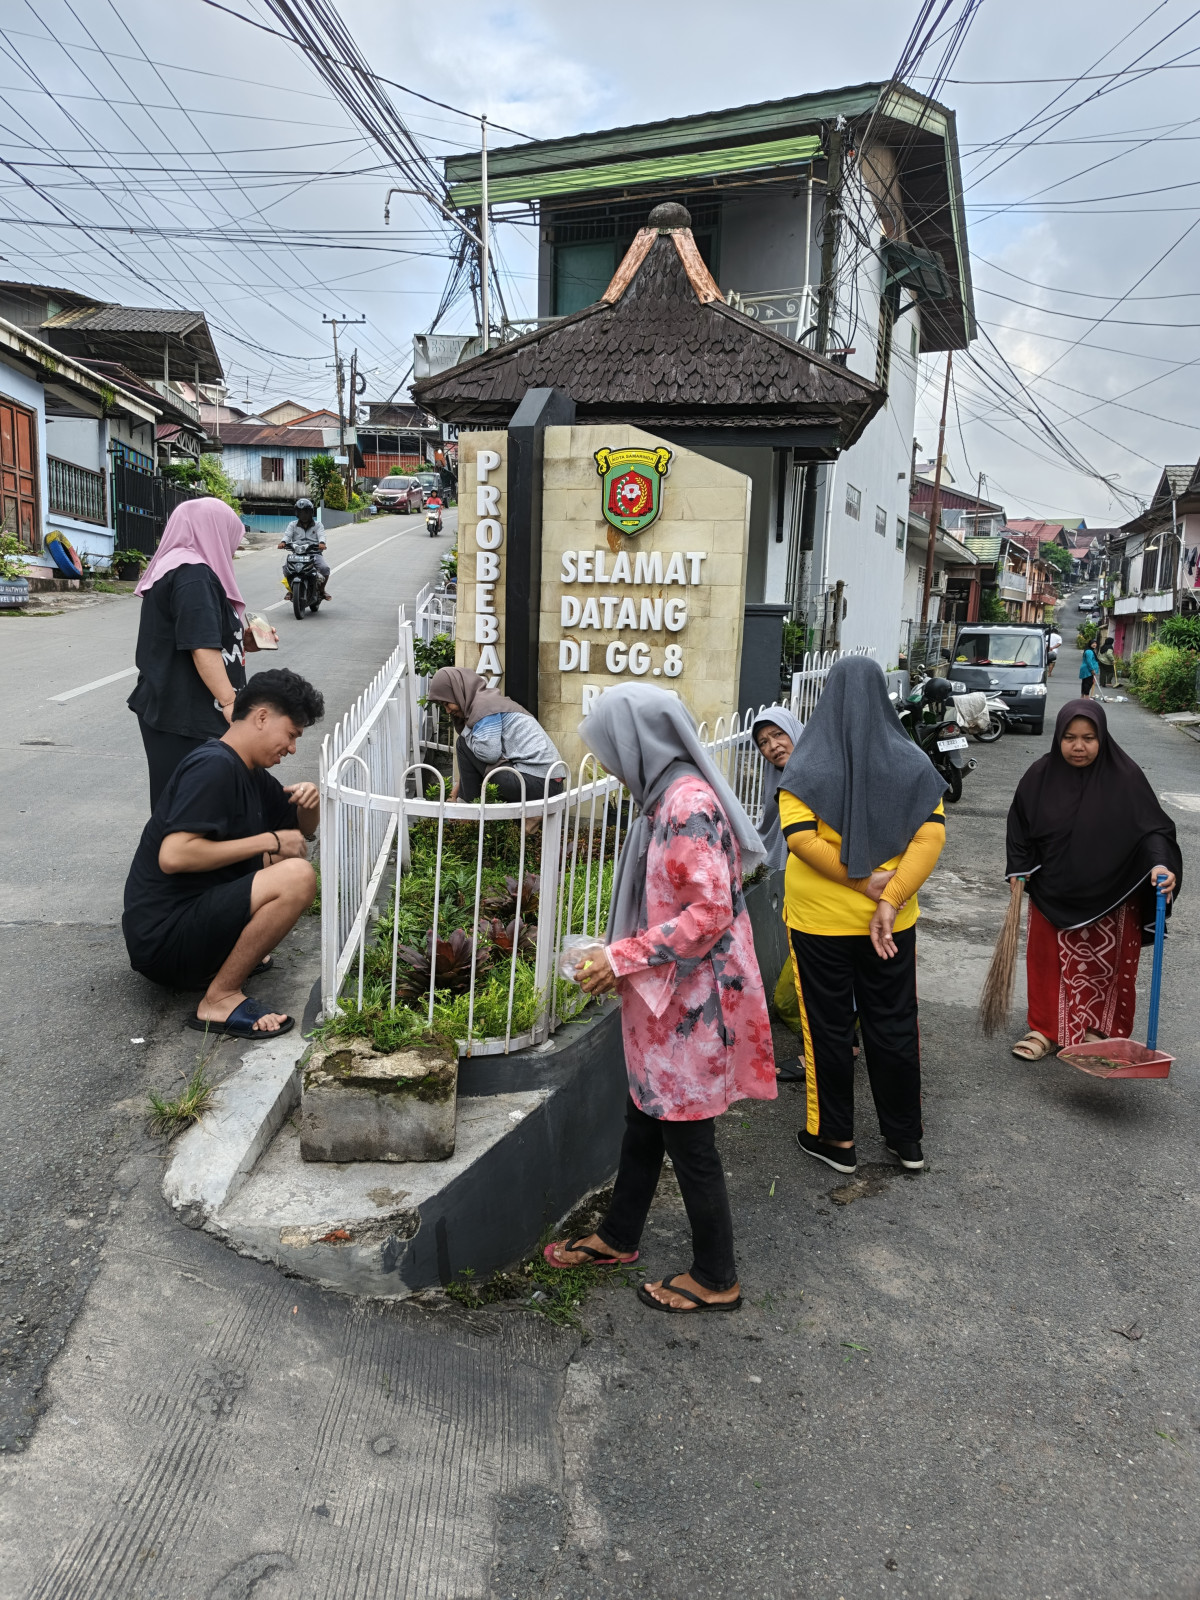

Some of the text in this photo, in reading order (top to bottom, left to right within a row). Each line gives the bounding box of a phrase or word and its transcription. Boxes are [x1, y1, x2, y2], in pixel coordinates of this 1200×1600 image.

[560, 550, 708, 585] SELAMAT
[560, 595, 688, 632] DATANG
[558, 640, 684, 677] DI GG.8
